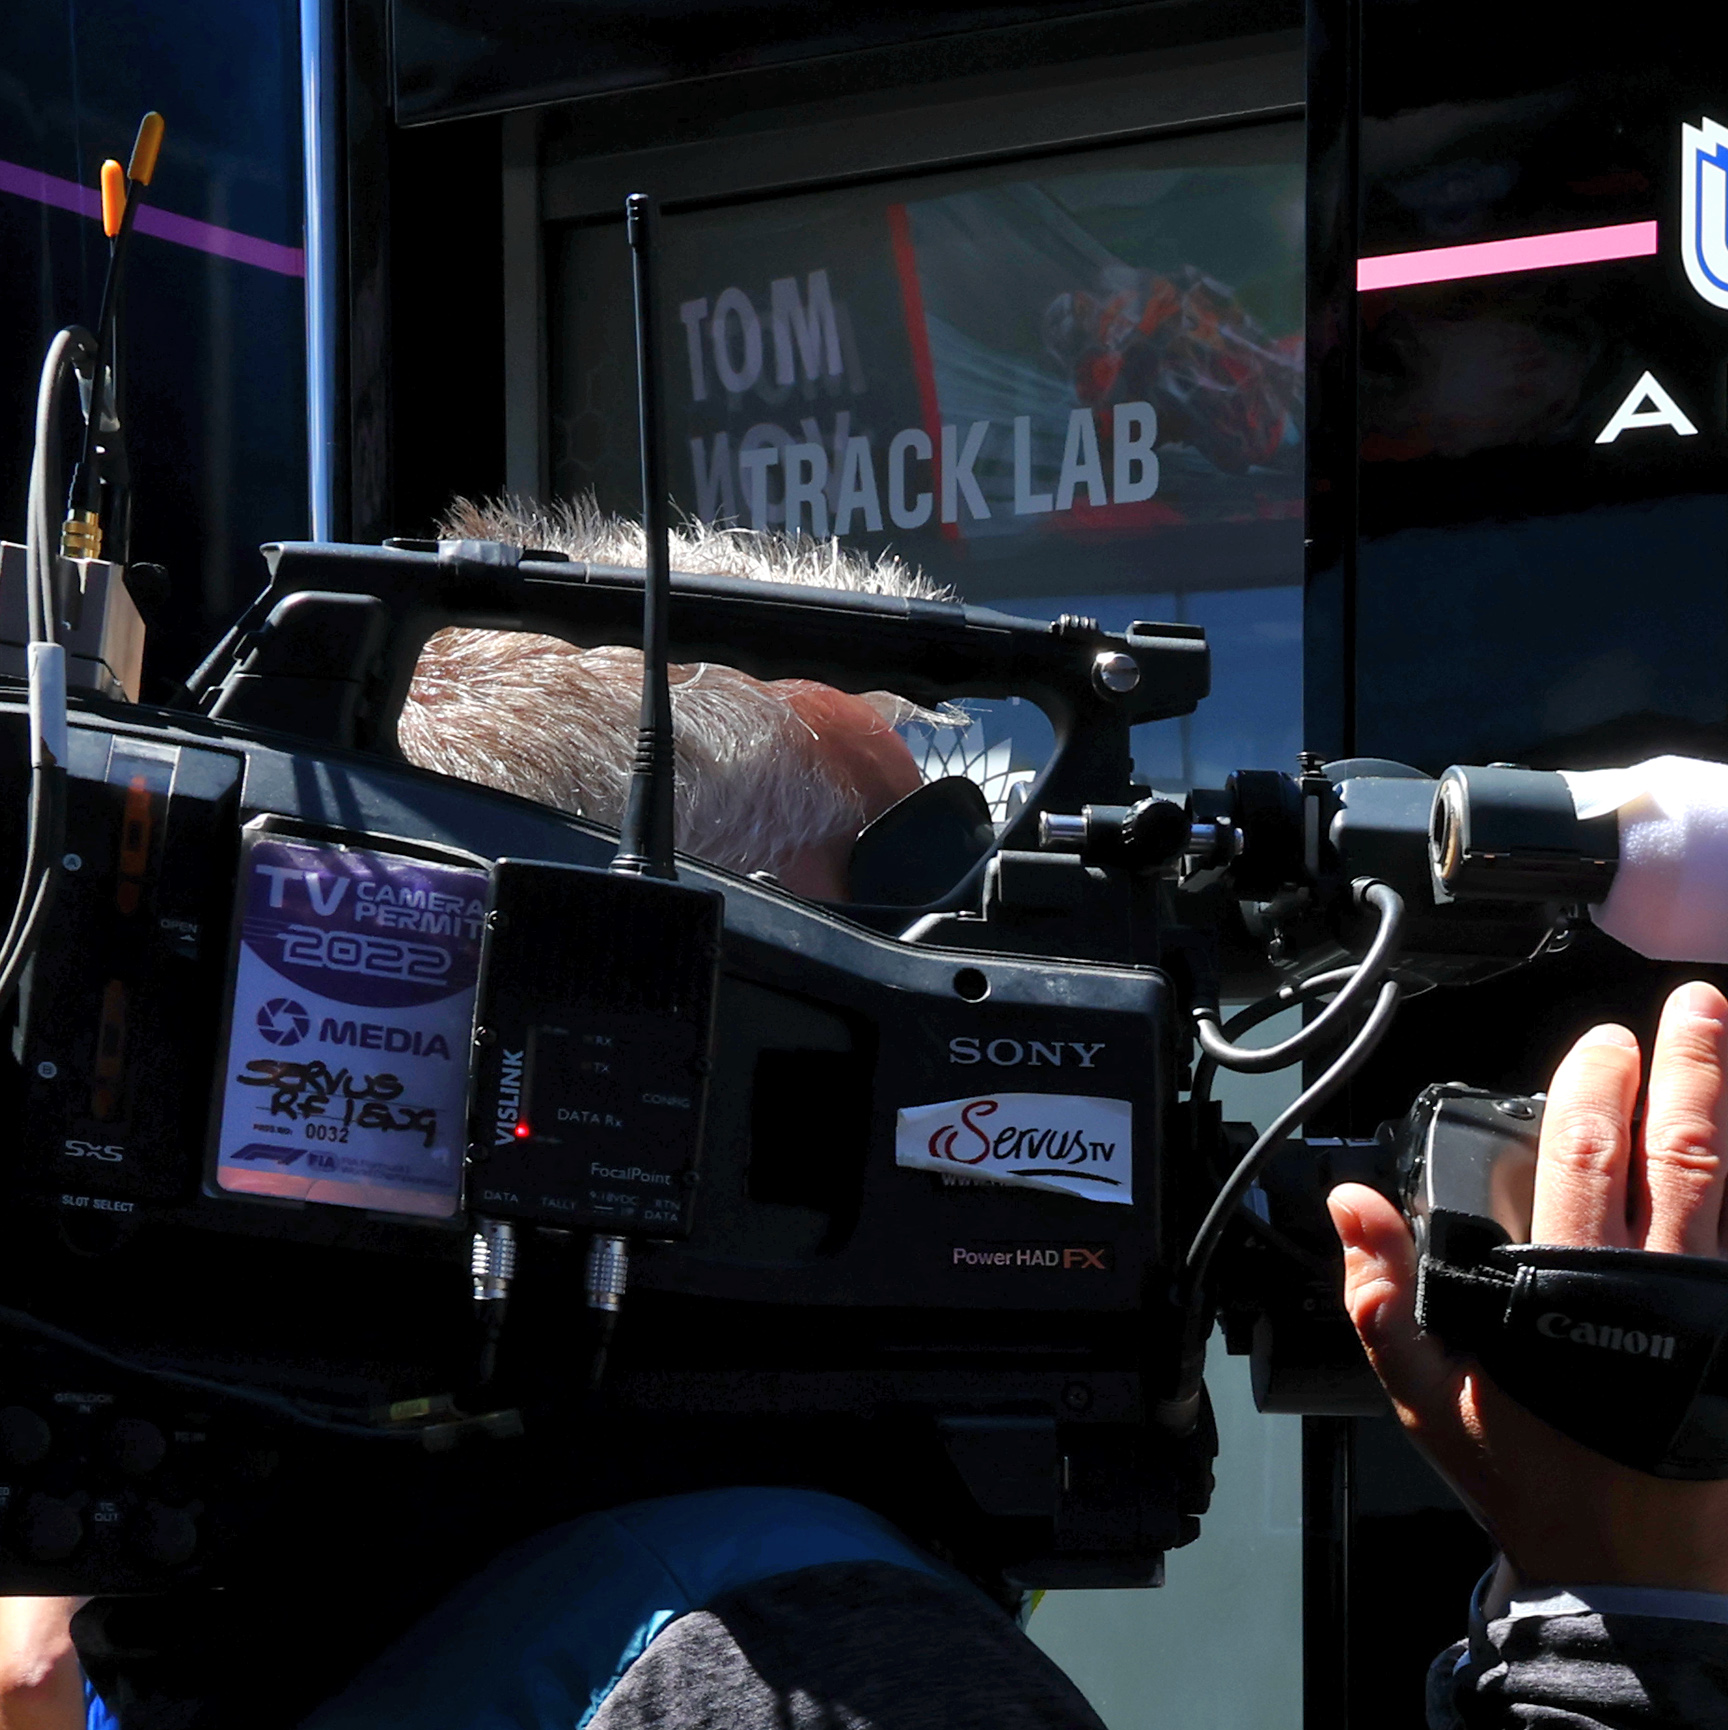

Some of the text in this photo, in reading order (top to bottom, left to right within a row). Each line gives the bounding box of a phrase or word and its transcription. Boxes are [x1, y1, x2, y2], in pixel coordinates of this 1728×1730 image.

[739, 401, 1160, 537] TRACK LAB
[255, 863, 351, 917] TV
[356, 881, 485, 917] CAMERA
[353, 901, 483, 942] PERMIT
[278, 923, 453, 987] 2022
[318, 1016, 451, 1060] MEDIA
[948, 1036, 1106, 1068] SONY
[493, 1048, 525, 1146] VISLINK
[304, 1122, 350, 1145] 0032
[556, 1107, 601, 1126] DATA
[590, 1161, 672, 1186] FocalPoint
[61, 1194, 135, 1213] SLOT SELECT
[953, 1247, 1106, 1270] Power HAD FX
[1535, 1309, 1676, 1361] Canon
